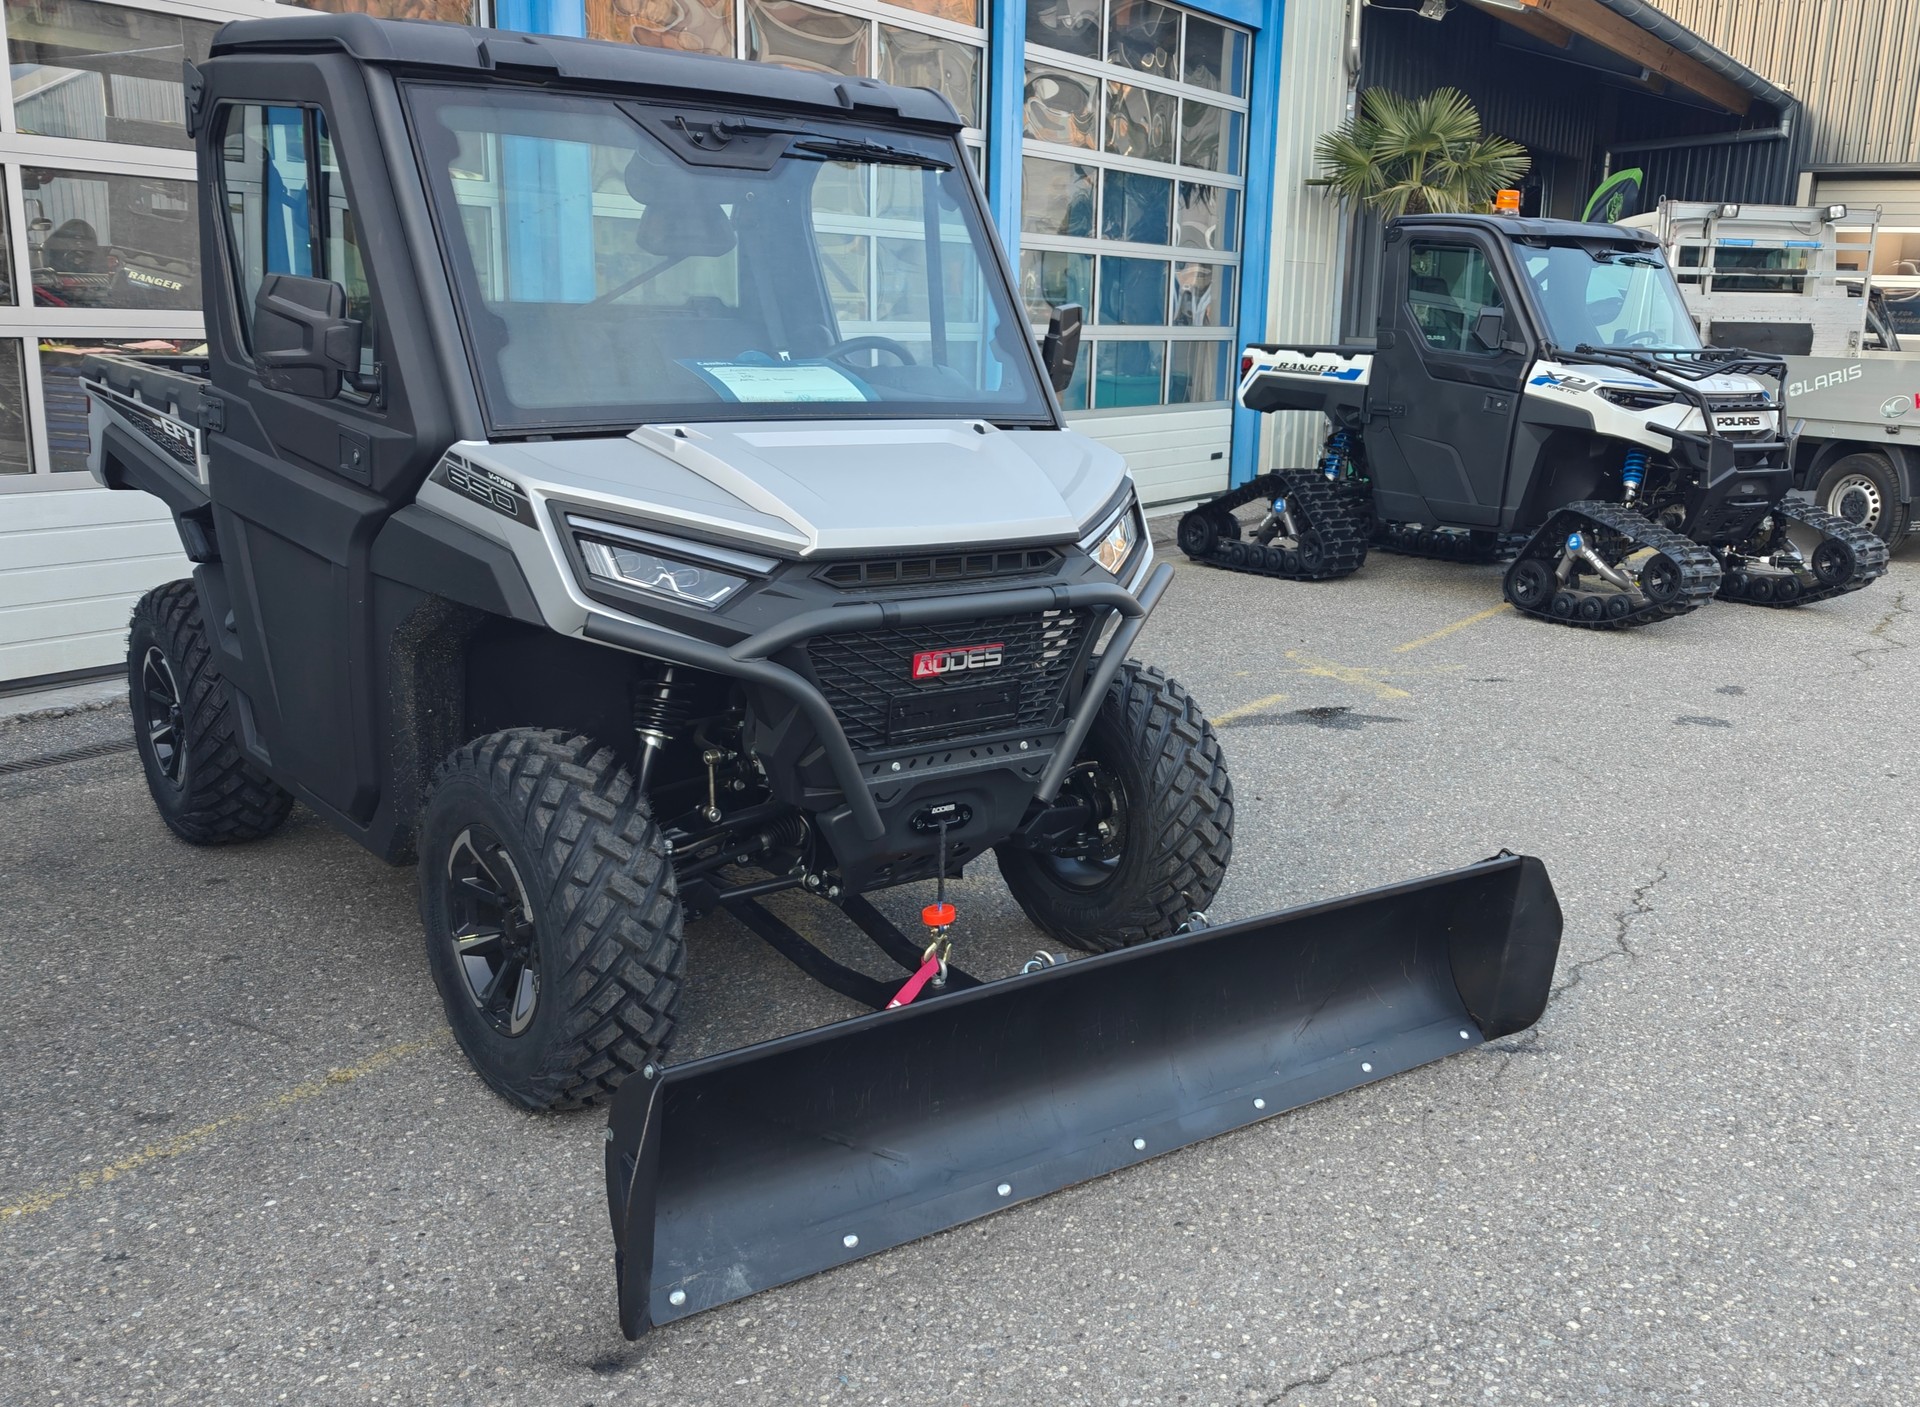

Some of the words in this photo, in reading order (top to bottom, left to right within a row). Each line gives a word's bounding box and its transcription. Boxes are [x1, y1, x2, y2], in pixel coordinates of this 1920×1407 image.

[128, 271, 182, 290] RANGER
[1278, 362, 1339, 373] RANGER
[1547, 384, 1580, 396] KINETIC
[1786, 364, 1862, 397] OLARIS
[1716, 416, 1761, 427] POLARIS
[446, 463, 518, 516] 650
[487, 471, 516, 490] V-TWIN
[915, 646, 1004, 676] AODES
